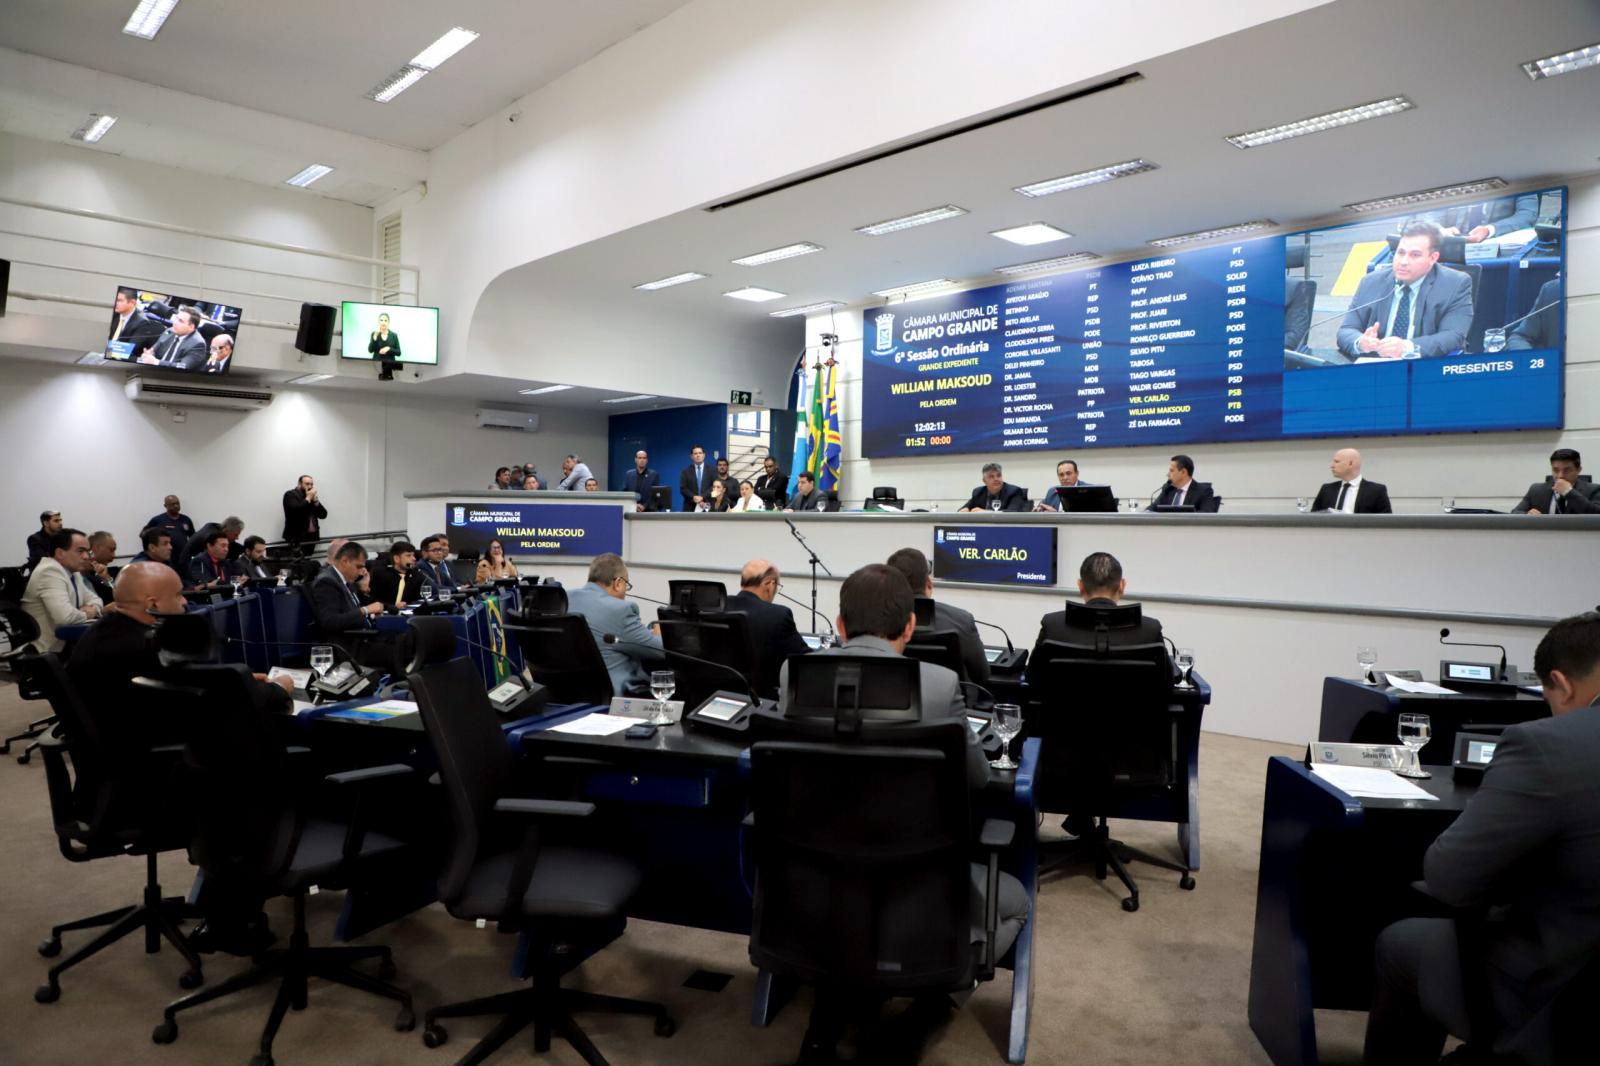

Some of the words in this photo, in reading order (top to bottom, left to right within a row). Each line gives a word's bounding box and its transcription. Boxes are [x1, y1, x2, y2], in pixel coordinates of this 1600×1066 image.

[1132, 263, 1149, 272] LUIZA
[1151, 259, 1175, 268] RIBEIRO
[1131, 275, 1154, 284] OTÁVIO
[1156, 272, 1173, 280] TRAD
[1226, 272, 1247, 281] SOLID
[1228, 285, 1246, 293] REDE
[1006, 295, 1026, 304] AYRTON
[1028, 291, 1049, 300] ARAÚJO
[1131, 299, 1148, 307] PROF.
[1150, 295, 1171, 305] ANDRÉ
[1227, 298, 1246, 306] PSDB
[1005, 306, 1028, 315] BETINHO
[1149, 309, 1167, 317] JUARI
[904, 313, 937, 328] CÂMARA
[939, 307, 984, 323] MUNICIPAL
[987, 305, 998, 315] DE
[1020, 316, 1039, 324] AVELAR
[1150, 320, 1180, 329] RIVERTON
[1226, 324, 1246, 332] PODE
[902, 325, 944, 343] CAMPO
[947, 317, 998, 336] GRANDE
[1005, 327, 1036, 336] CLAUDINHO
[1159, 330, 1195, 340] GUERREIRO
[1082, 341, 1102, 349] UNIÃO
[907, 347, 938, 362] Sessão
[941, 341, 989, 357] Ordinária
[1005, 350, 1029, 358] CORONEL
[918, 362, 942, 371] GRANDE
[944, 358, 979, 368] EXPEDIENTE
[1019, 360, 1044, 368] PINHEIRO
[1130, 359, 1154, 367] TABOSA
[1442, 361, 1513, 375] PRESENTES
[1530, 359, 1544, 368] 28
[1151, 370, 1175, 378] VARGAS
[892, 380, 934, 394] WILLIAM
[937, 374, 992, 390] MAKSOUD
[935, 398, 956, 407] ORDEM
[1157, 406, 1190, 414] MAKSOUD
[1149, 418, 1181, 426] FARMÁCIA
[915, 422, 945, 432] 12:02:13
[906, 437, 925, 446] 01:52
[930, 436, 951, 445] 00:00
[496, 527, 535, 536] WILLIAM
[538, 528, 584, 537] MAKSOUD
[959, 548, 981, 559] VER.
[984, 547, 1027, 560] CARLÃO
